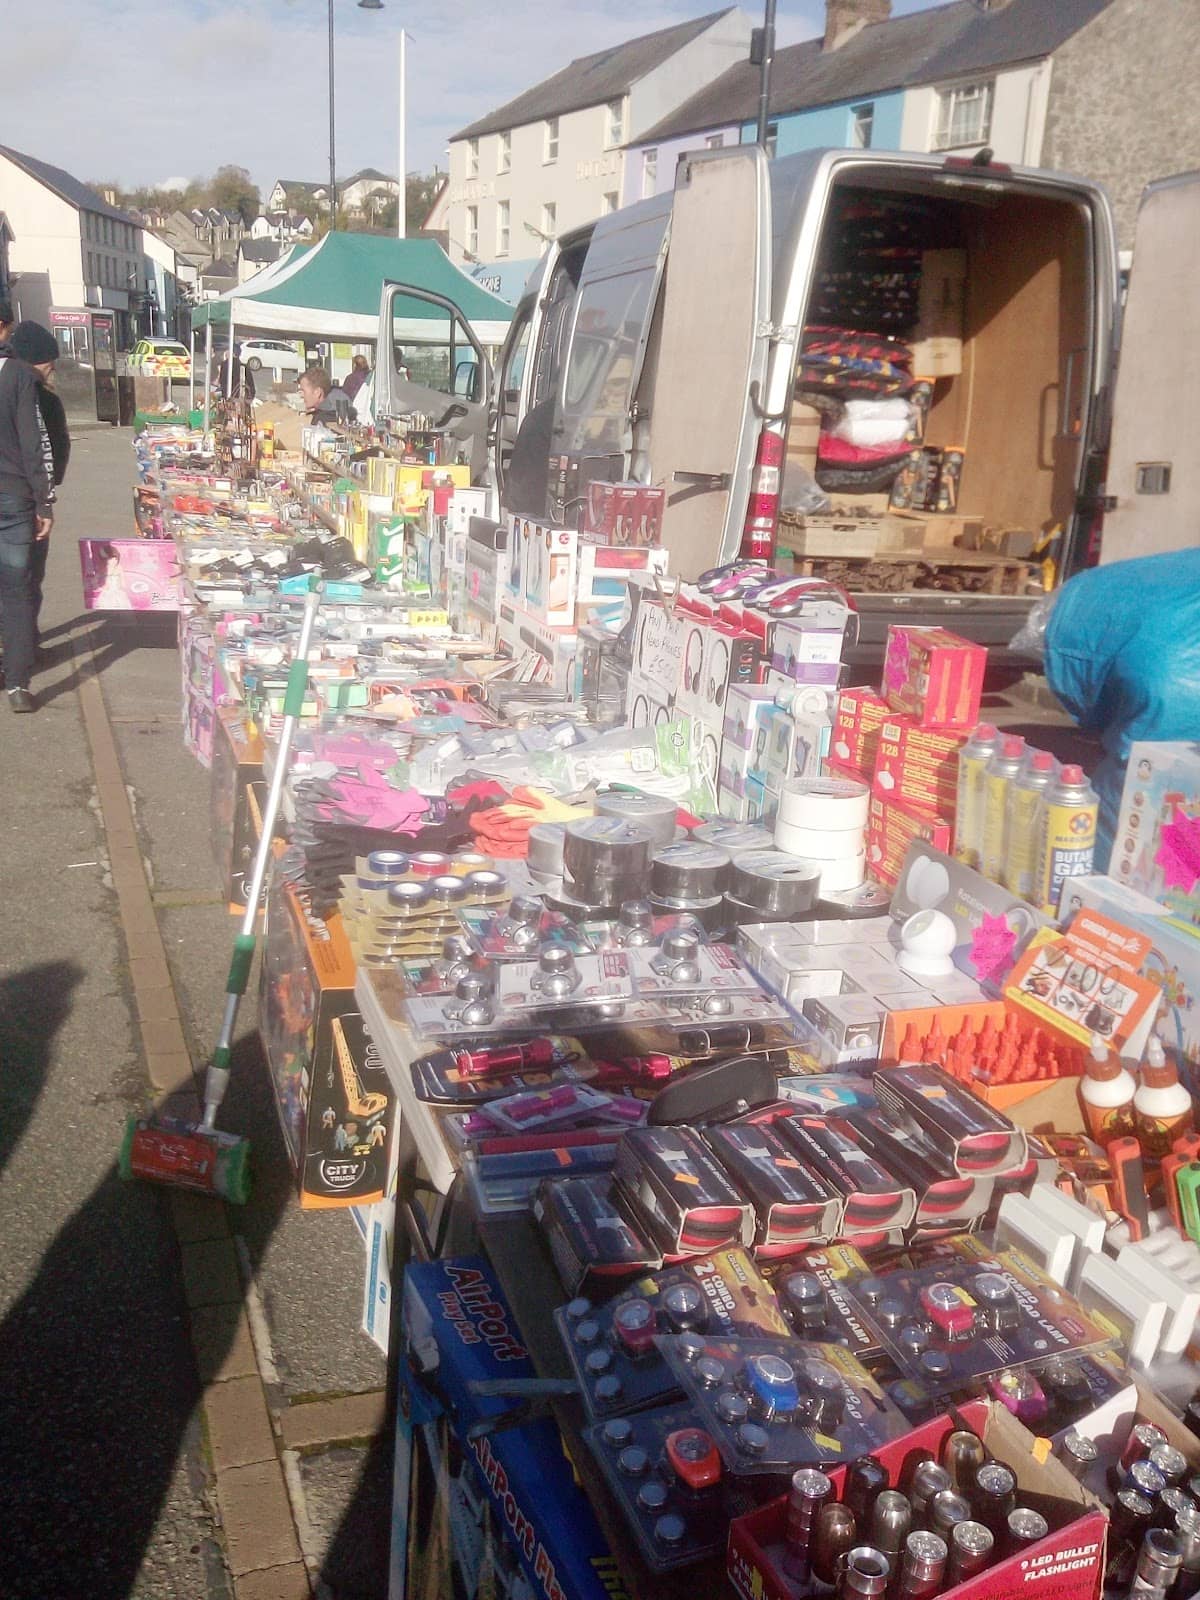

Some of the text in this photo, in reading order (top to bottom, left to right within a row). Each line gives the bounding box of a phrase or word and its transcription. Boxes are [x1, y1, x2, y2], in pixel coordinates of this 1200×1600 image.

[839, 715, 855, 729] 128
[881, 742, 899, 758] 128
[871, 816, 883, 832] 128
[326, 1164, 360, 1177] CITY
[329, 1173, 356, 1183] TRUCK
[692, 1260, 716, 1277] 2
[805, 1252, 829, 1269] 2
[701, 1277, 718, 1297] LED
[710, 1274, 737, 1311] COMBO
[1000, 1271, 1040, 1305] COMBO
[815, 1268, 832, 1288] LED
[827, 1287, 851, 1317] HEAD
[845, 1316, 870, 1346] LAMP
[436, 1291, 483, 1345] Play Set
[1037, 1319, 1070, 1345] LAMP
[1020, 1543, 1099, 1571] 9 LED BULLET
[1023, 1556, 1097, 1582] FLASHLIGHT
